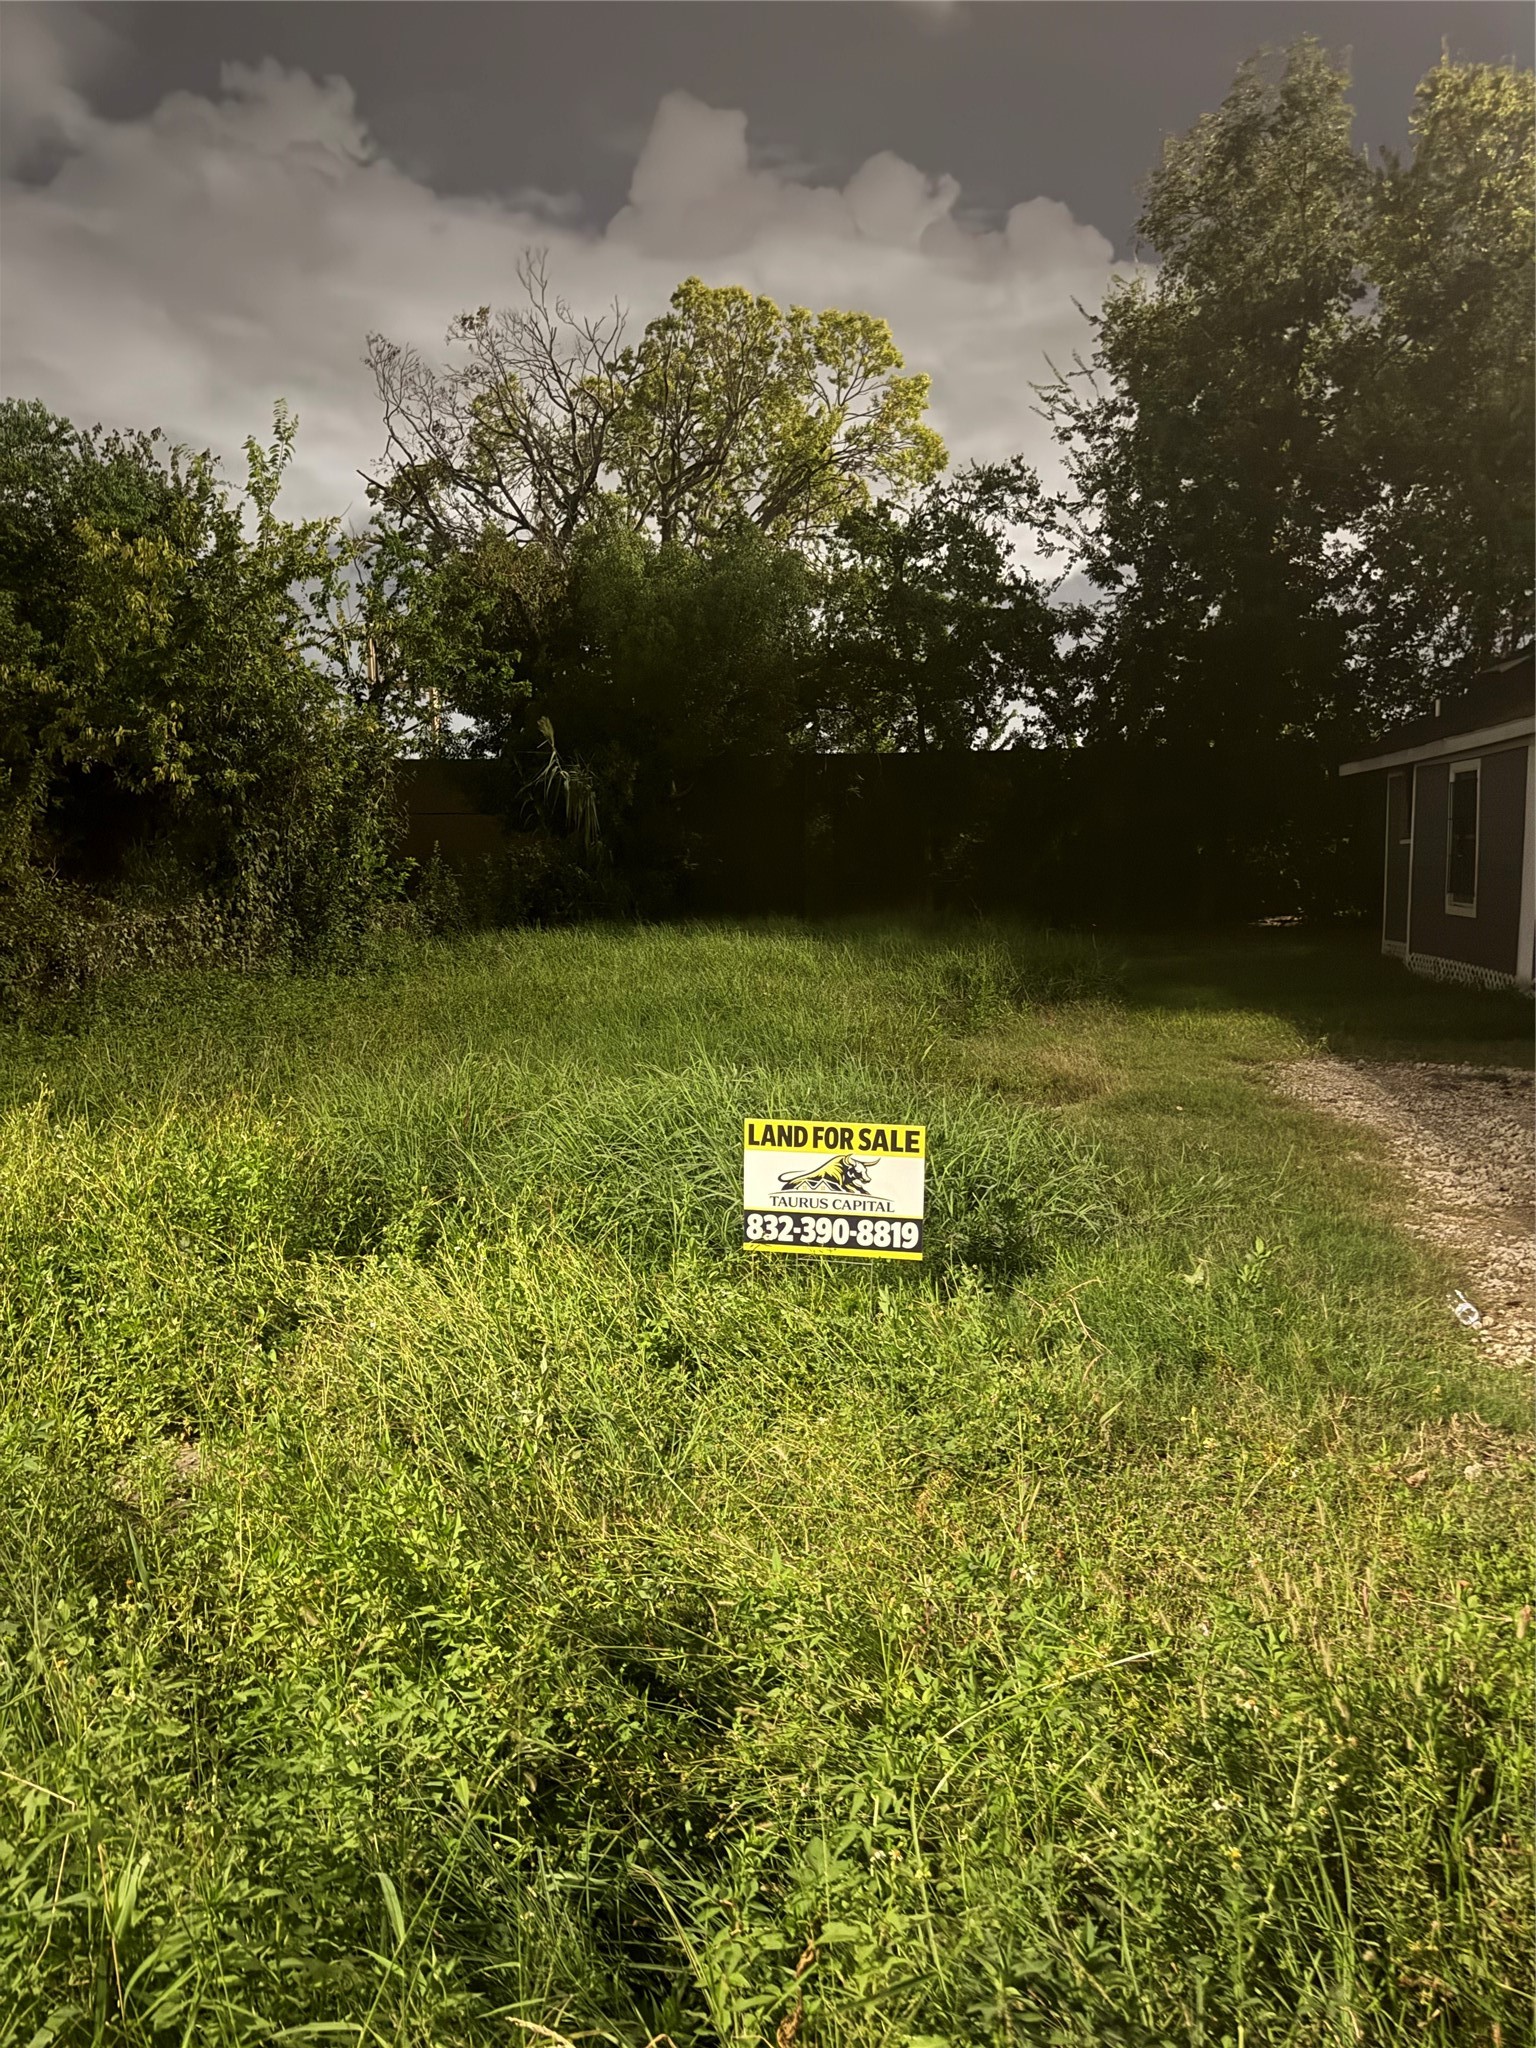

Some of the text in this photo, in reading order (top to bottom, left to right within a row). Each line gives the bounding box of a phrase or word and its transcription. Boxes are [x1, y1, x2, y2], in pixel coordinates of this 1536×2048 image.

[748, 1123, 920, 1153] LAND FOR SALE
[769, 1196, 895, 1213] TAURUS CAPITAL
[746, 1213, 919, 1249] 832-390-8819
